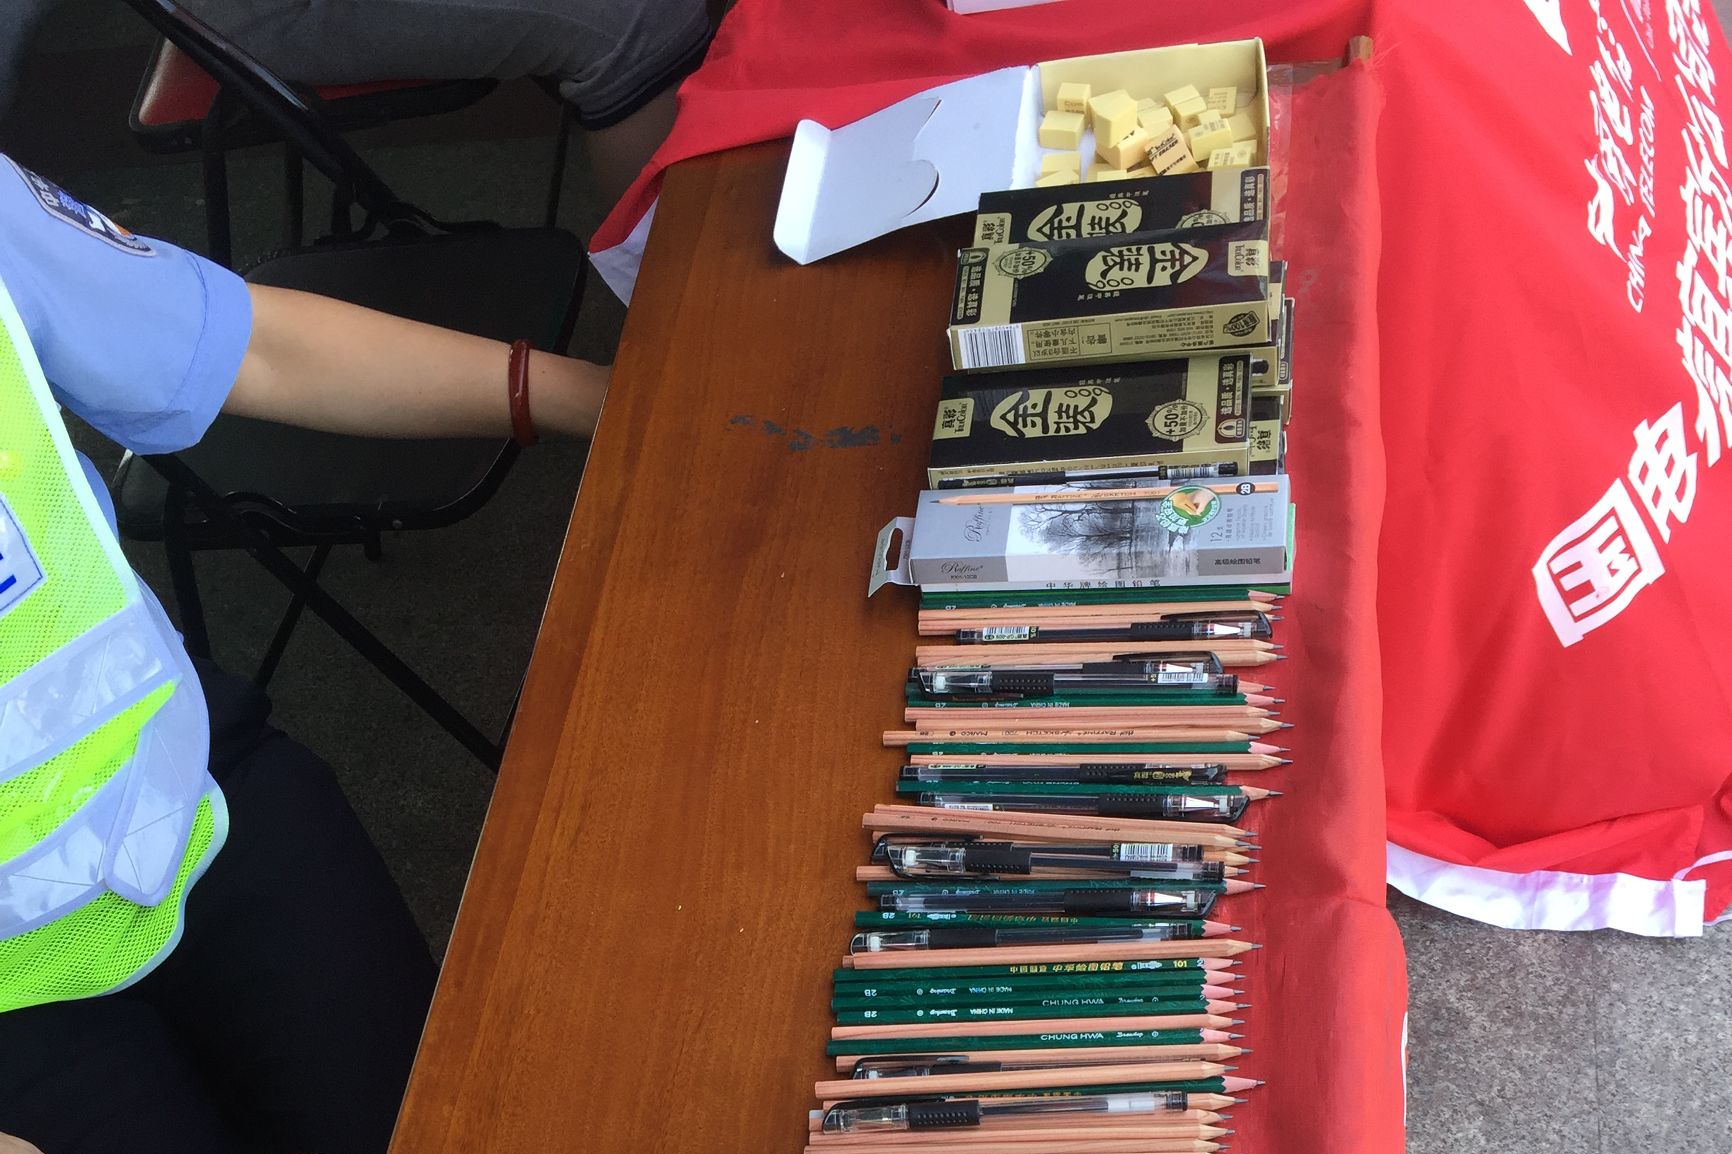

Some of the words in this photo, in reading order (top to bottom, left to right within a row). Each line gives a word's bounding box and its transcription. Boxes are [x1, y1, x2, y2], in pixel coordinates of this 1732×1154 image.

[1637, 85, 1656, 218] TELECOM
[1626, 215, 1653, 313] CHINA
[1240, 483, 1252, 494] 2B
[1172, 959, 1188, 969] 101
[864, 1010, 878, 1019] 2B
[1040, 1033, 1077, 1042] CHUNG
[1079, 1032, 1105, 1041] HWA
